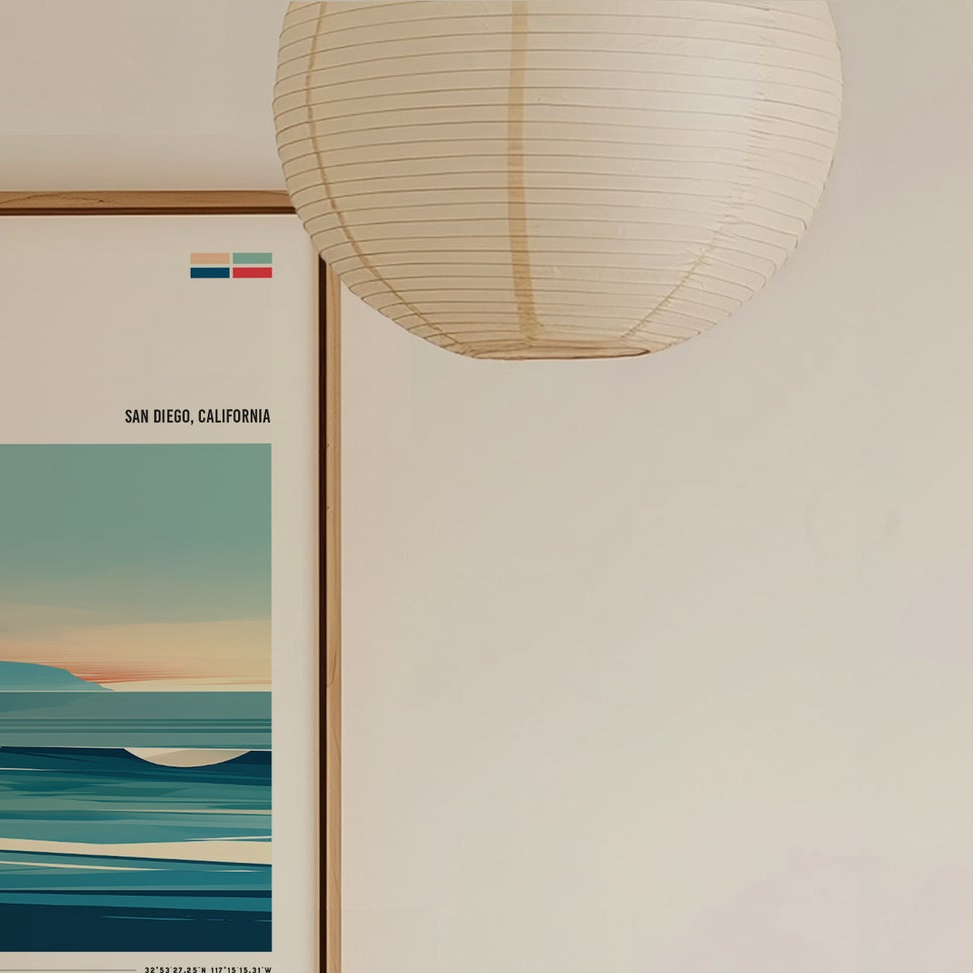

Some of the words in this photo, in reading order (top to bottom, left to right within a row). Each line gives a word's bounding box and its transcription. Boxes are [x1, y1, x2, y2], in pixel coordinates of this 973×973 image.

[125, 409, 148, 423] SAN
[154, 409, 194, 425] DIEGO,
[198, 408, 270, 423] CALIFORNIA
